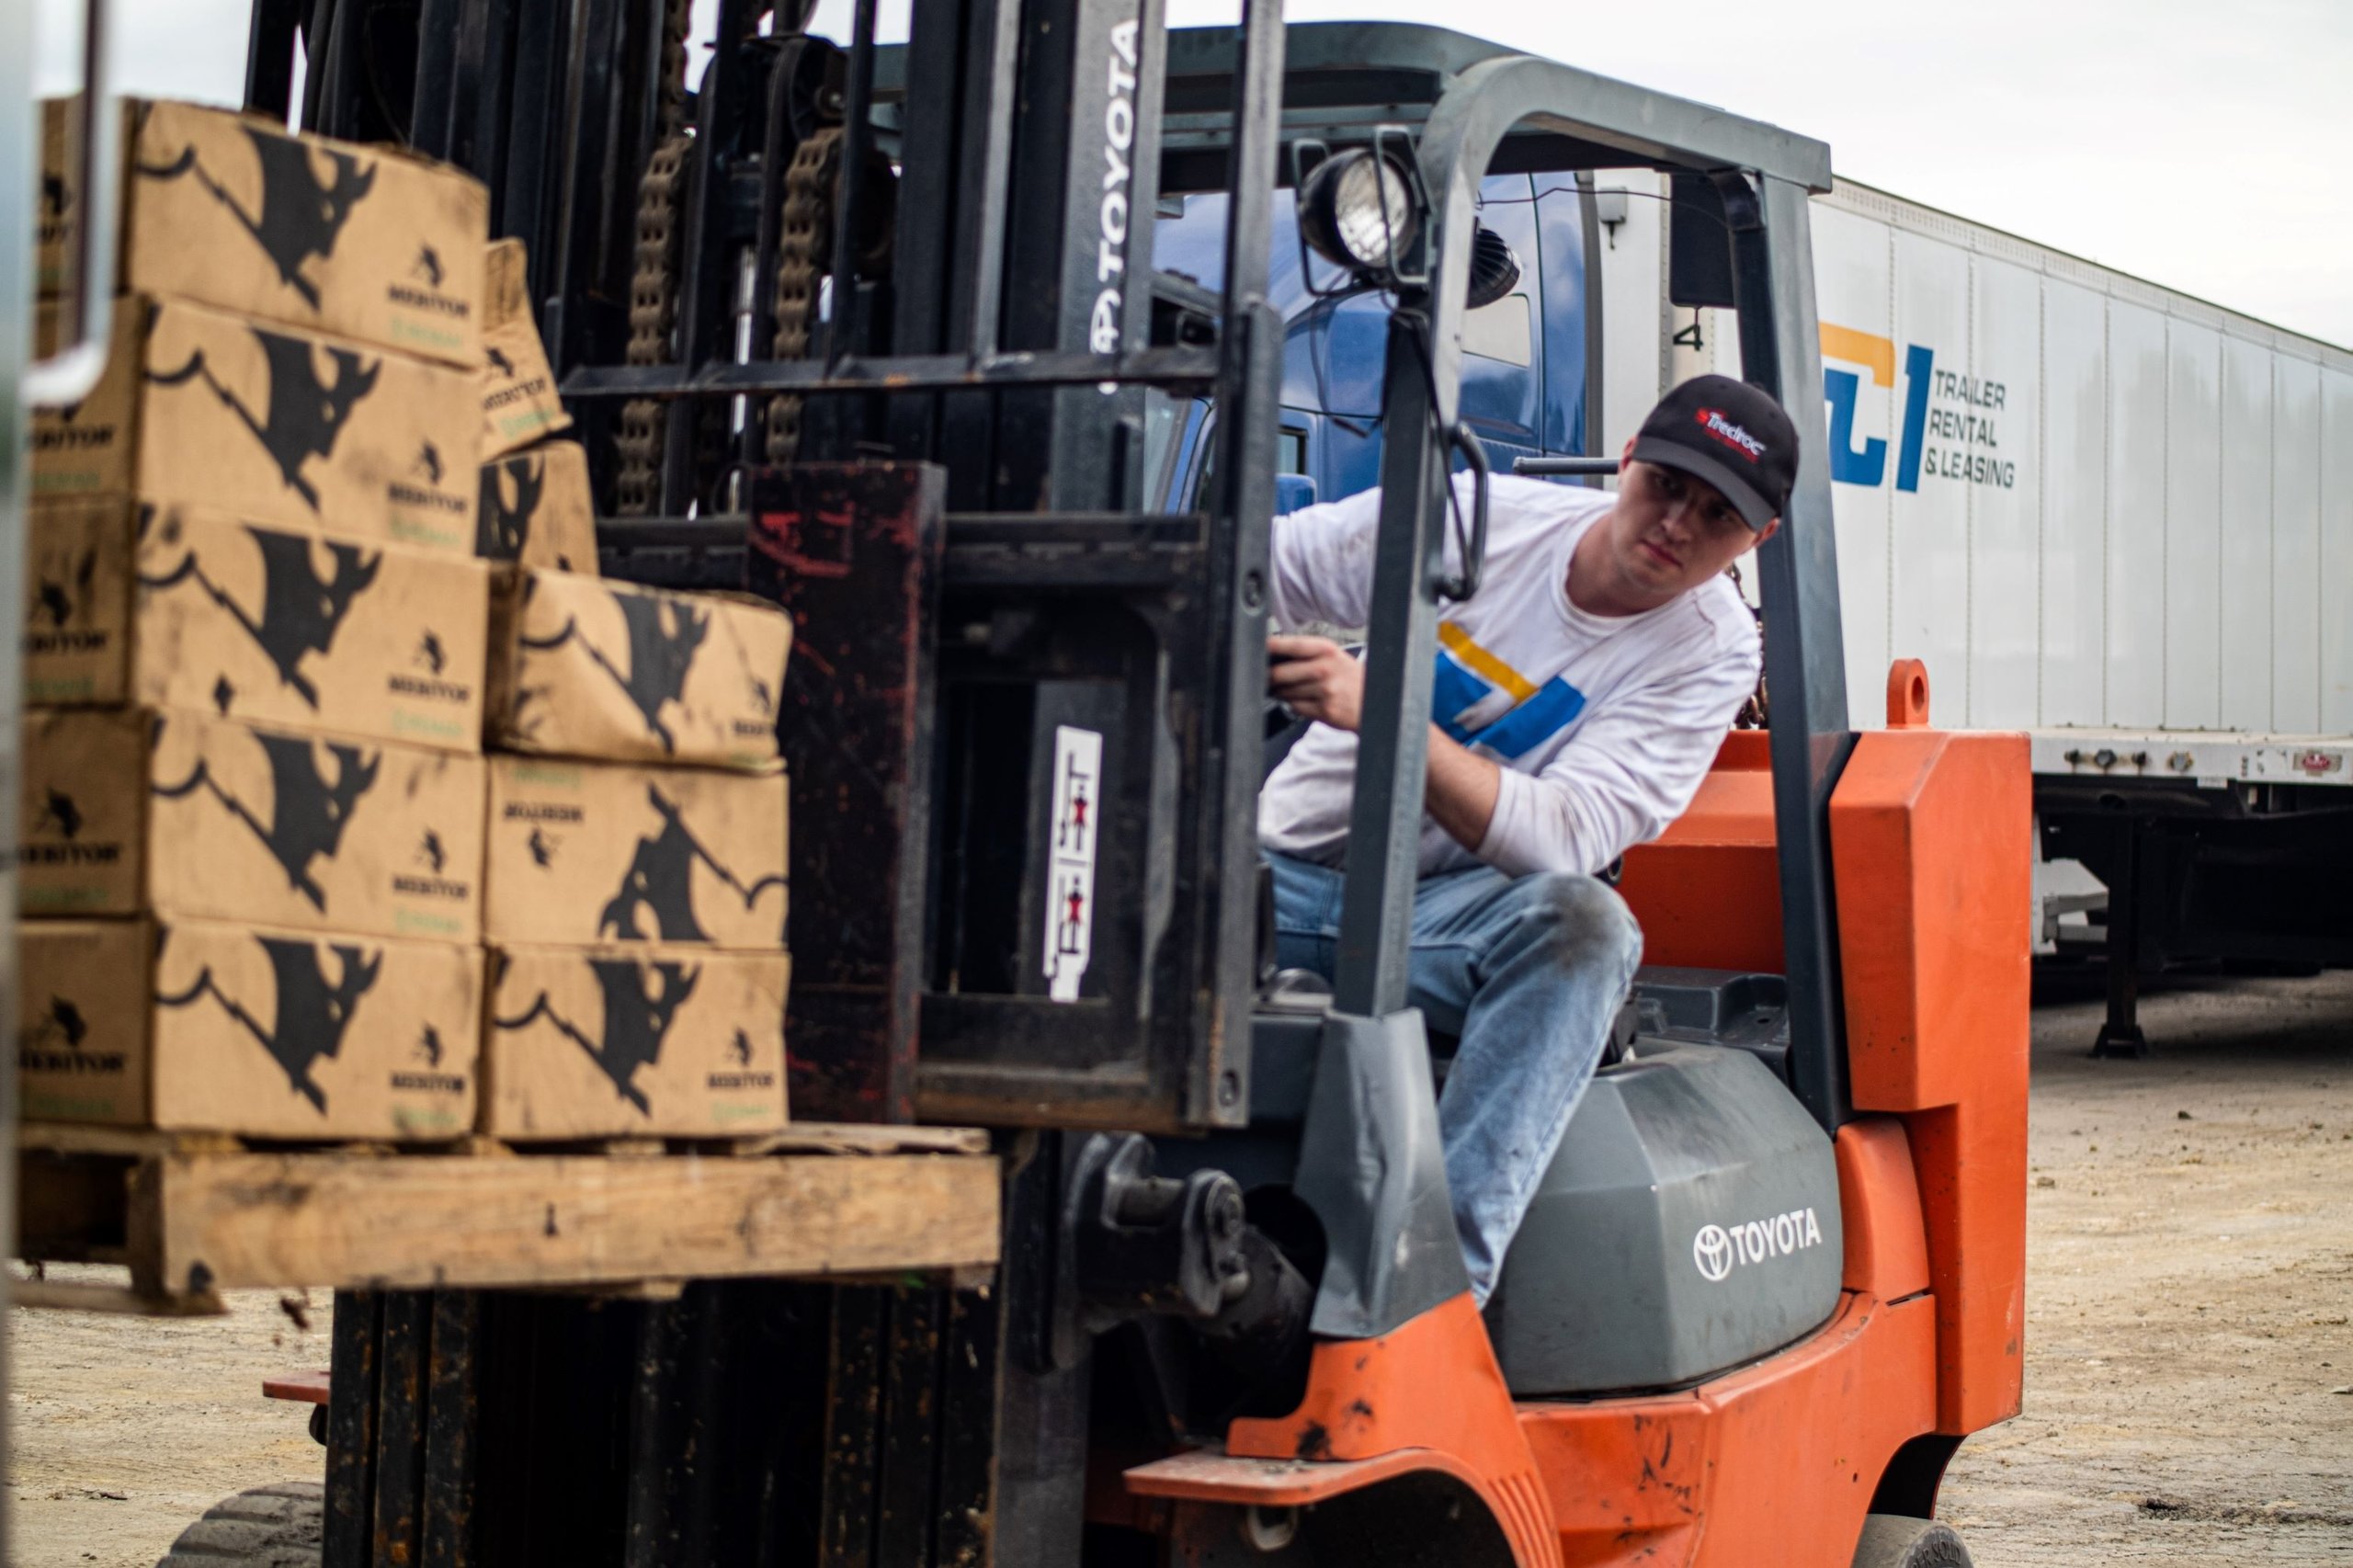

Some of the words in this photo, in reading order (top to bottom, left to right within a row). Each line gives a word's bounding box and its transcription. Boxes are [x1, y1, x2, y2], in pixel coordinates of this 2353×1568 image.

[1097, 18, 1140, 283] TOYOTA
[1673, 324, 1703, 351] 4
[1936, 369, 2006, 411] TRAILER
[1707, 411, 1767, 455] Tredroc
[1929, 408, 1997, 448] RENTAL
[1925, 447, 1937, 475] &
[1941, 450, 2015, 489] LEASING
[1729, 1208, 1822, 1266] TOYOTA
